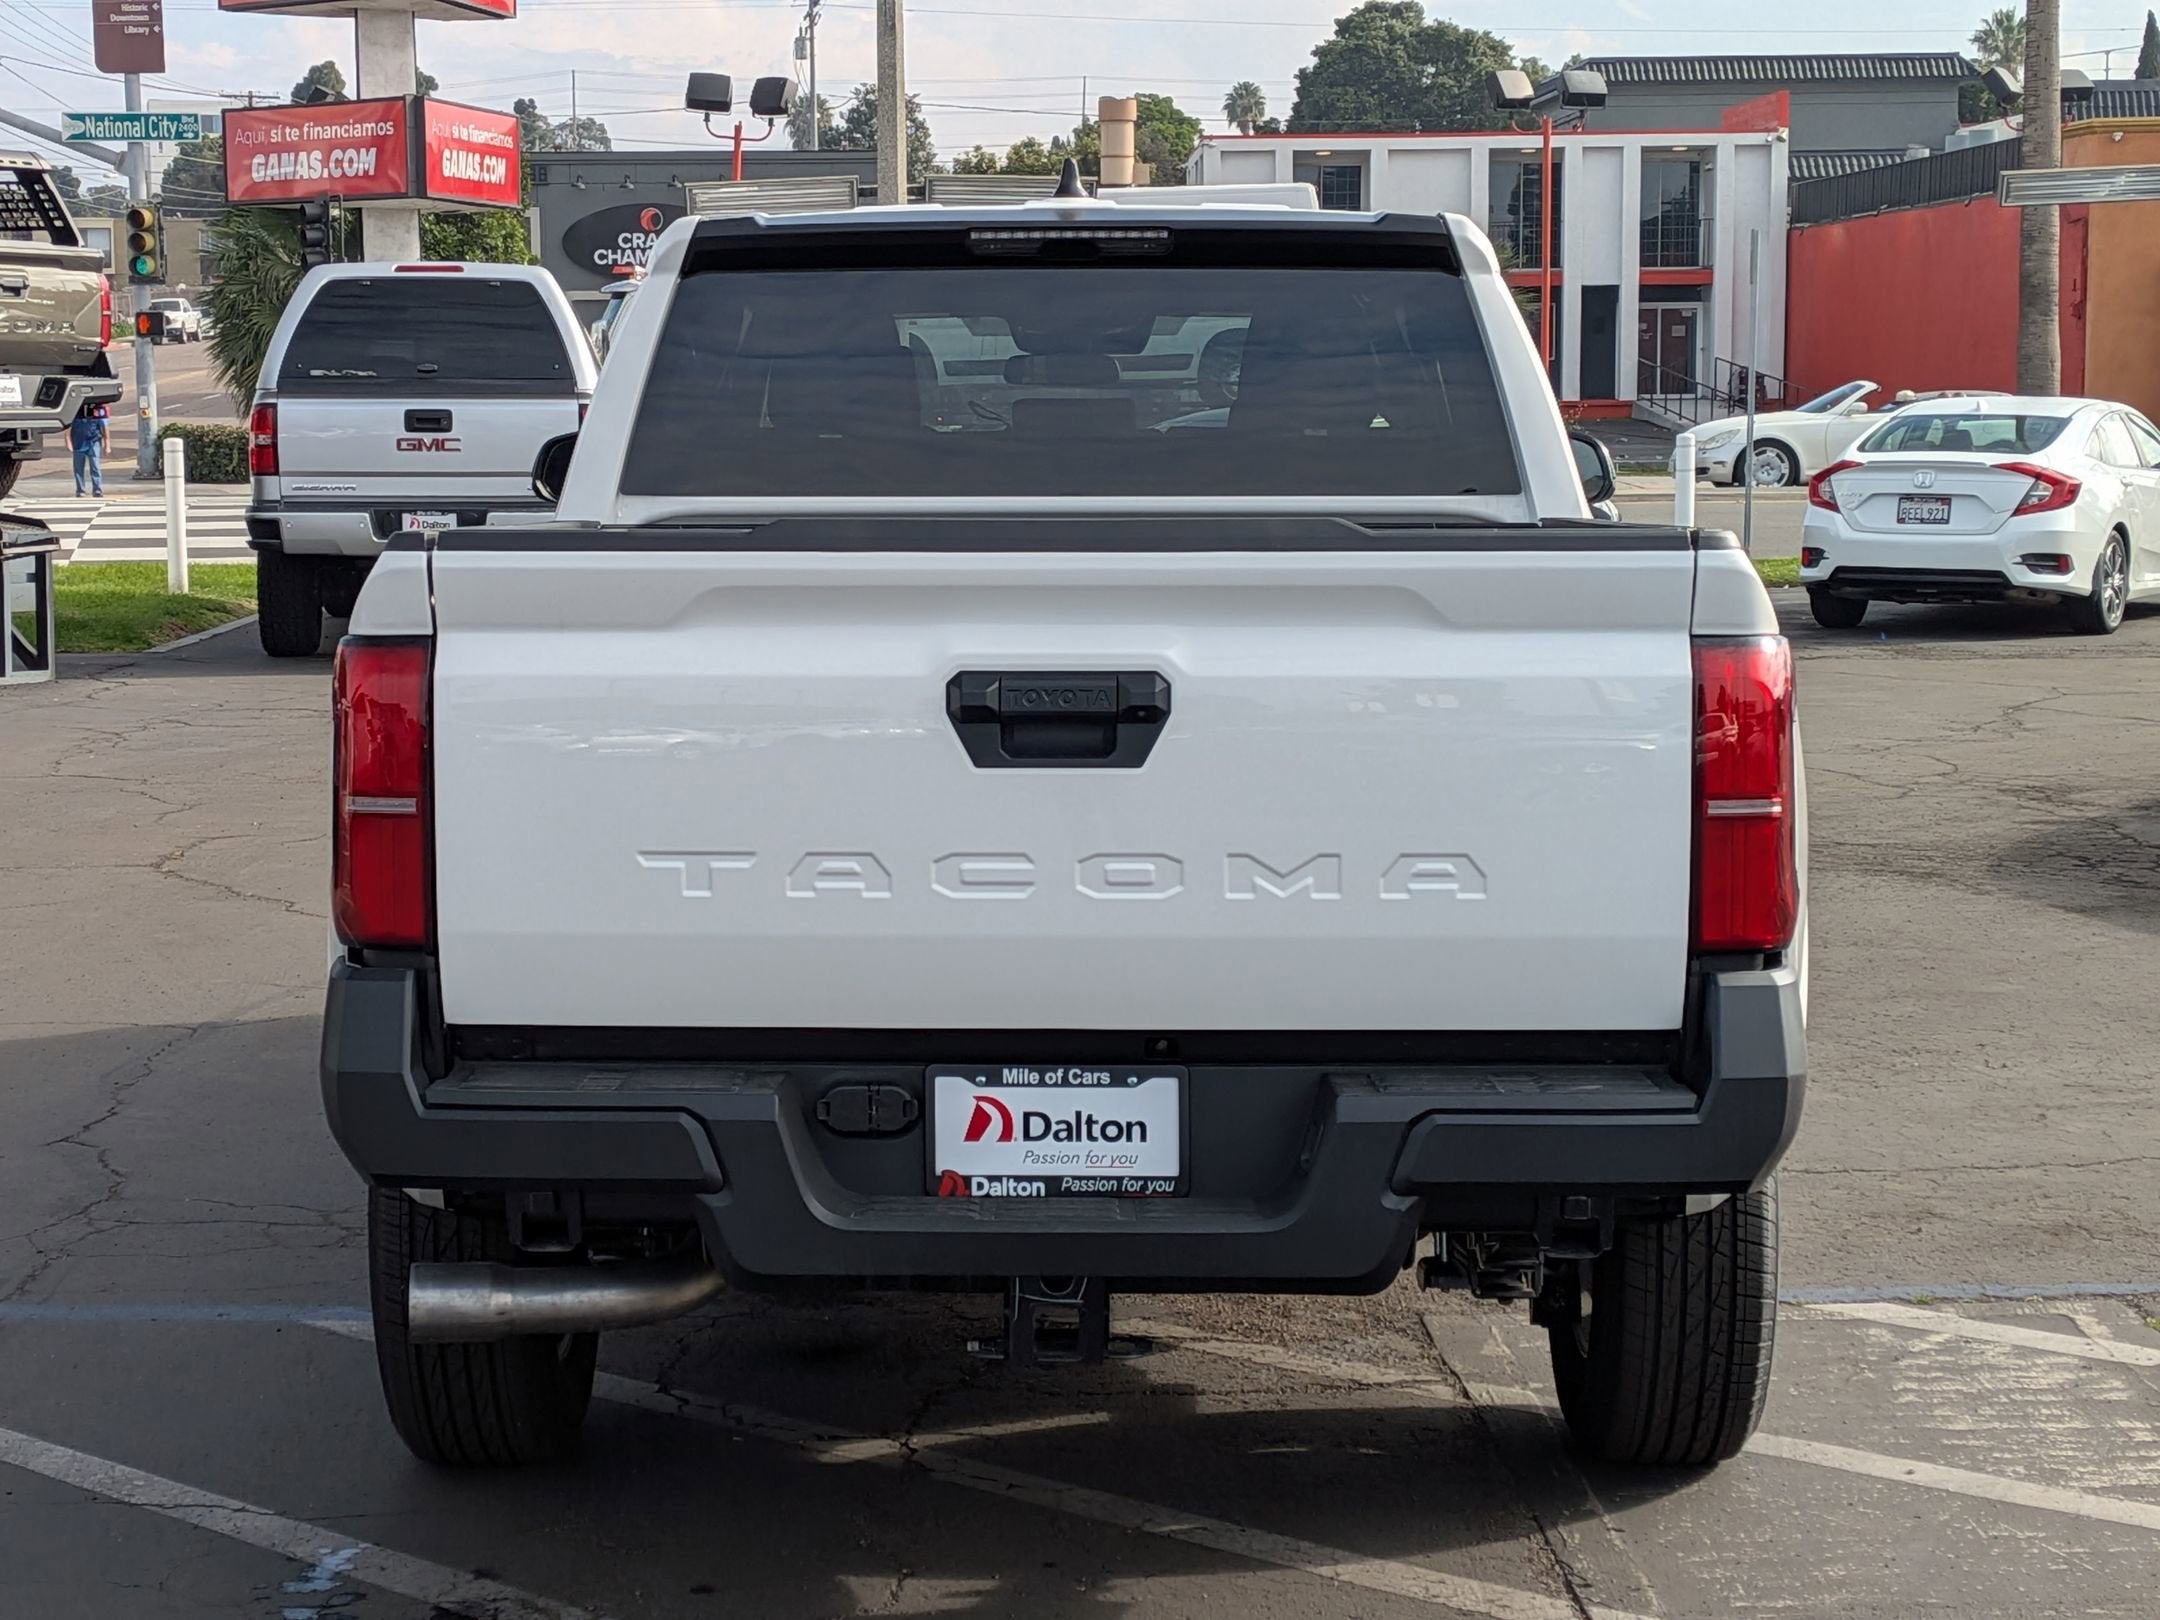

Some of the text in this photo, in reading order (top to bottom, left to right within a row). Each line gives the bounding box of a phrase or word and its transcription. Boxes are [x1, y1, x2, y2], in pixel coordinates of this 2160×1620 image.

[124, 25, 150, 36] Library
[85, 116, 178, 139] National City
[178, 123, 199, 132] 2400
[270, 124, 282, 143] sí
[285, 125, 299, 142] te
[303, 119, 395, 141] financiamos
[468, 123, 514, 150] financiamos
[251, 147, 377, 183] GANAS.COM
[442, 147, 507, 185] GANAS.COM
[396, 437, 462, 452] GMC
[1006, 688, 1112, 708] TOYOTA
[636, 850, 1488, 901] TACOMA
[1002, 1067, 1111, 1085] Mile of Cars
[1022, 1110, 1148, 1143] Dalton
[1022, 1150, 1138, 1167] Passion for you
[971, 1176, 1046, 1197] Dalton
[1061, 1177, 1175, 1194] Passion for you
